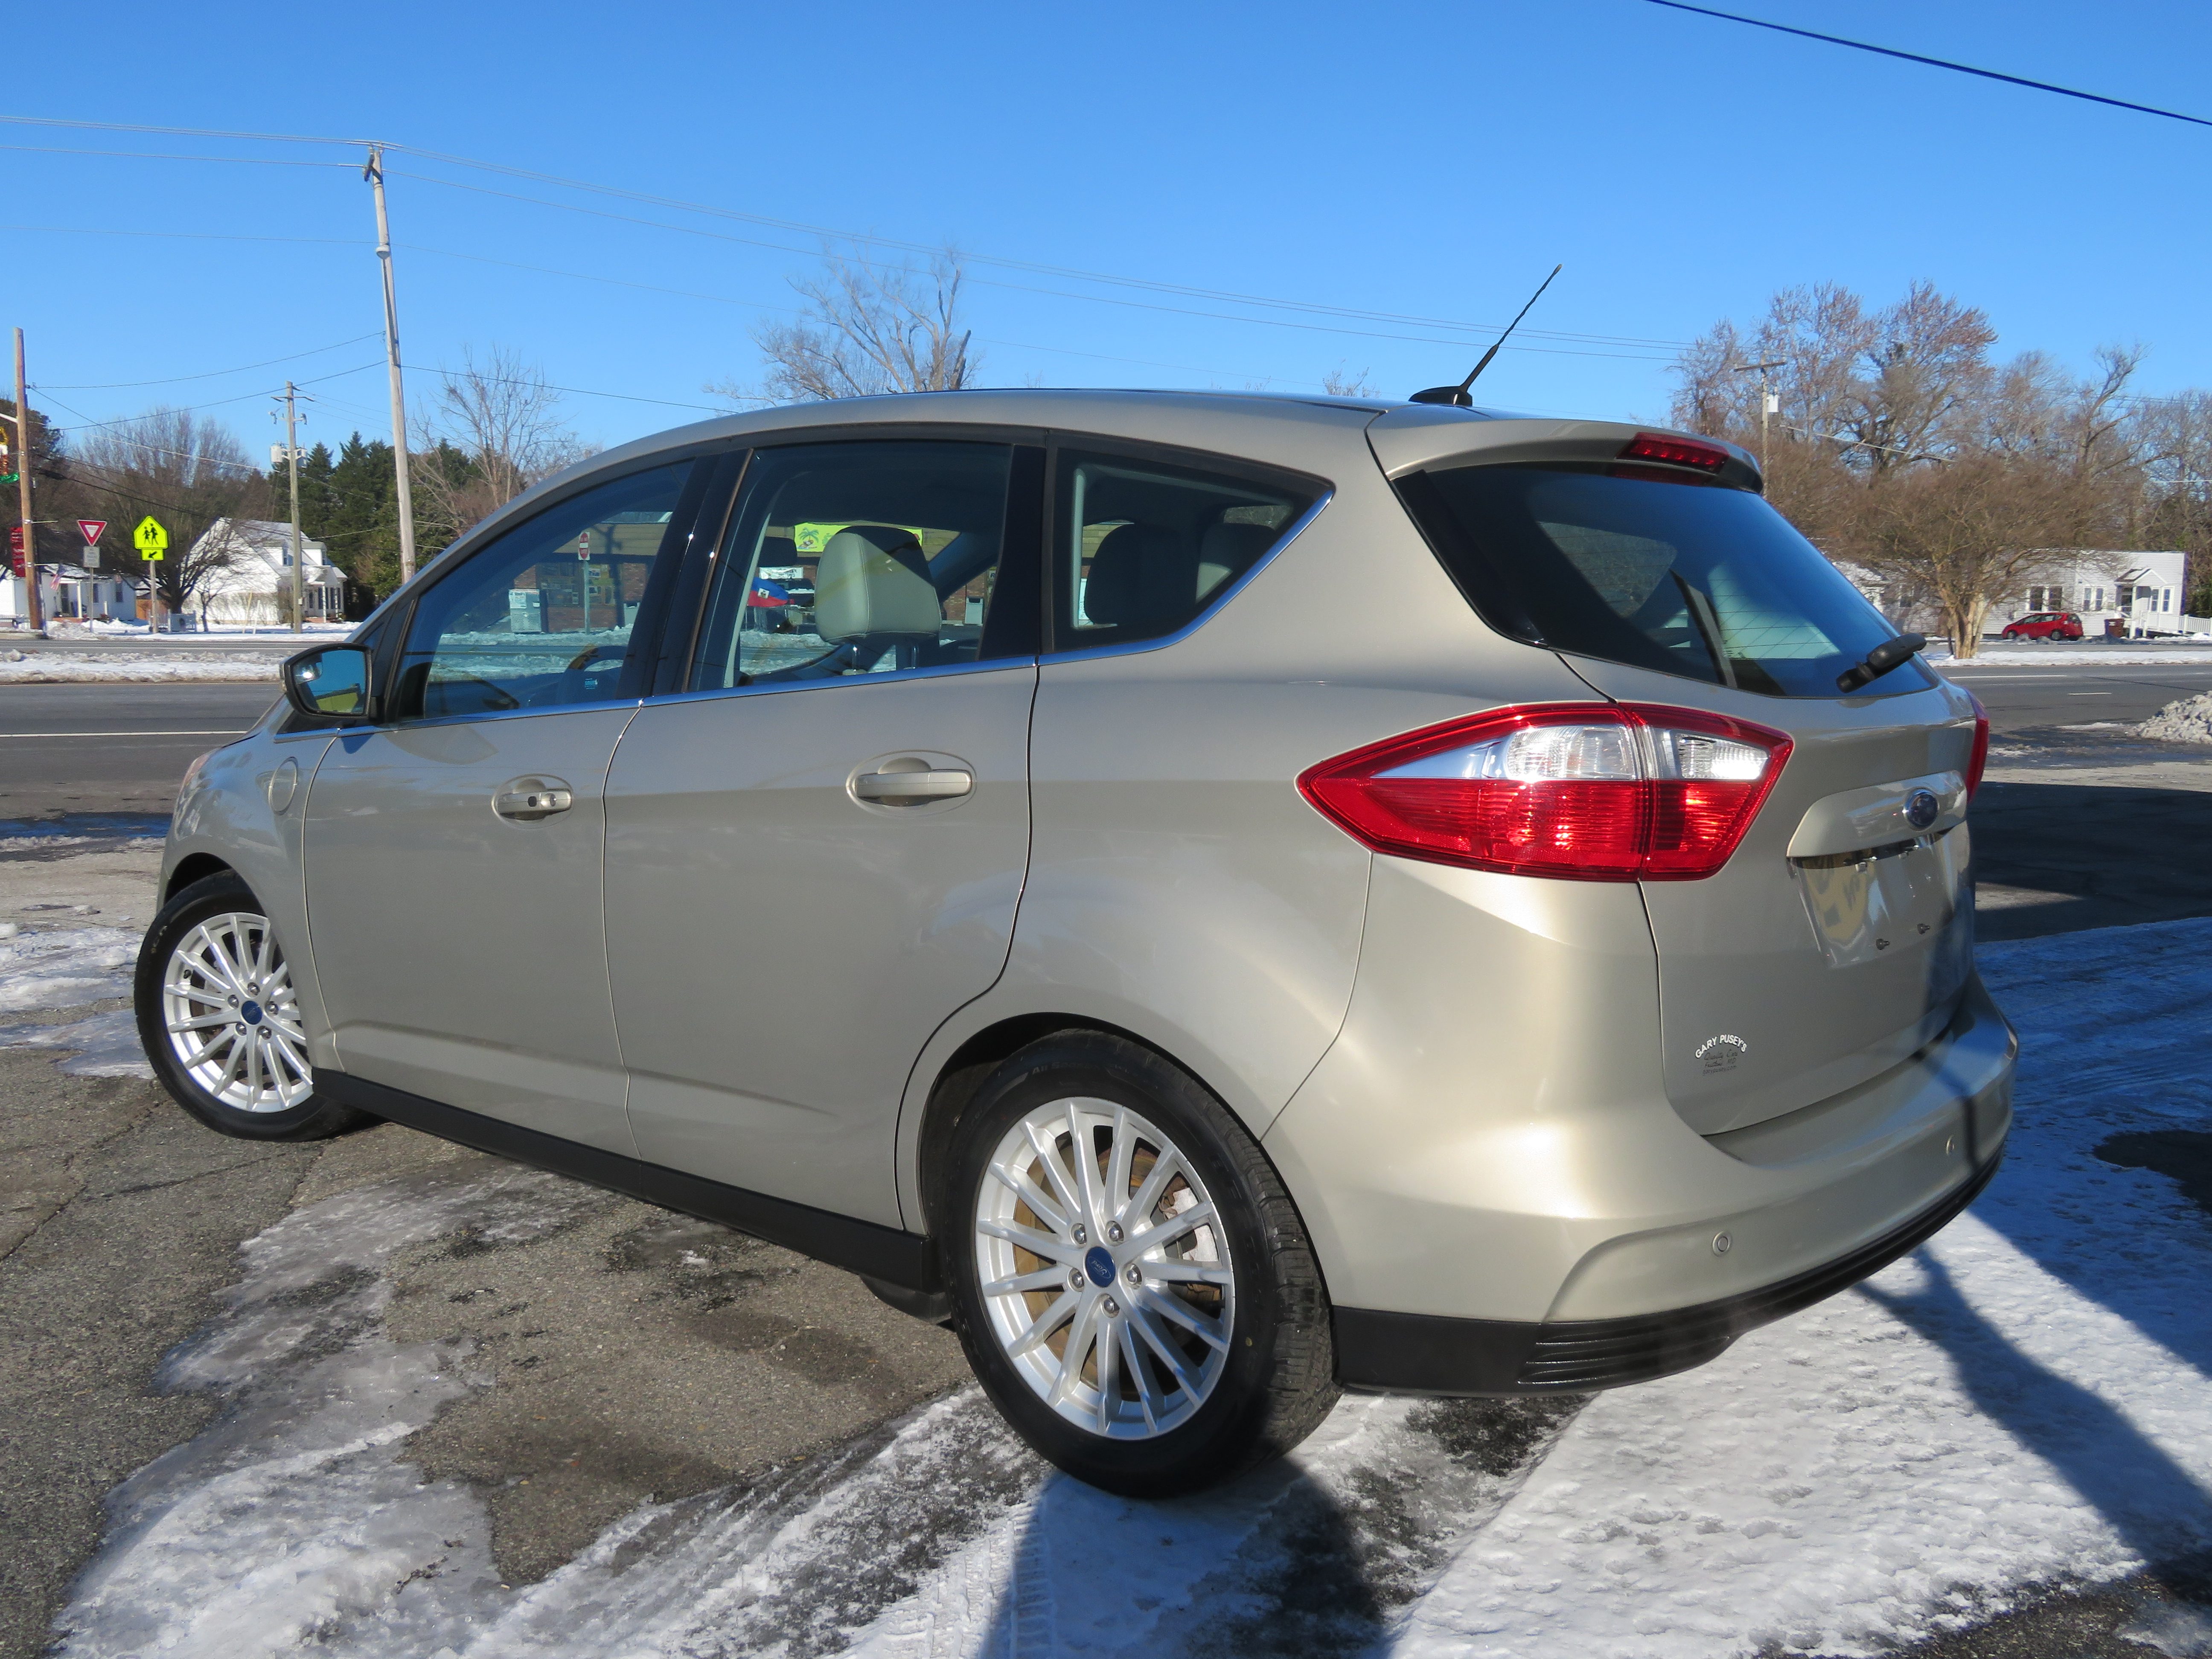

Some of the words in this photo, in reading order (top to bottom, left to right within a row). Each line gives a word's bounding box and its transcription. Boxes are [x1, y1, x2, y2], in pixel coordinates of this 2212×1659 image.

[1695, 1036, 1717, 1058] GARY
[1719, 1034, 1747, 1052] PUSEY'S
[1091, 1260, 1107, 1276] Ford
